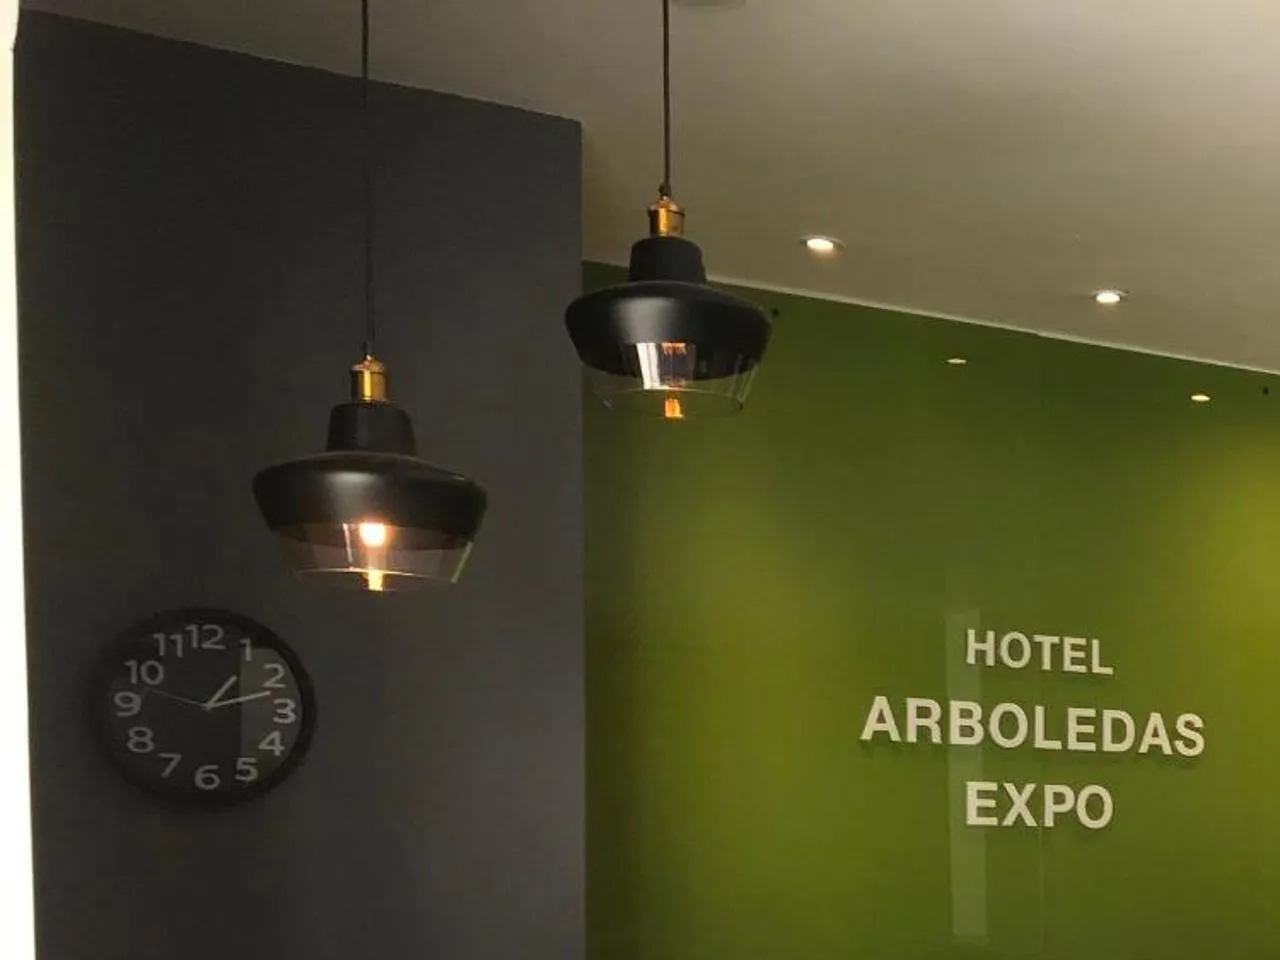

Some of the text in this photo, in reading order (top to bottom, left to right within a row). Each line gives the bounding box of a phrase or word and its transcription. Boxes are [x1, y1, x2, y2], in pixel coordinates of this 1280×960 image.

[153, 633, 184, 658] 11
[184, 624, 226, 650] 12
[239, 638, 252, 662] 1
[966, 629, 1114, 675] HOTEL
[124, 660, 164, 685] 10
[262, 663, 286, 688] 2
[113, 691, 142, 717] 9
[272, 698, 297, 724] 3
[860, 696, 1205, 756] ARBOLEDAS
[126, 726, 154, 753] 8
[258, 730, 285, 756] 4
[158, 752, 182, 778] 7
[194, 765, 220, 790] 6
[235, 757, 258, 782] 5
[966, 781, 1114, 829] EXPO
